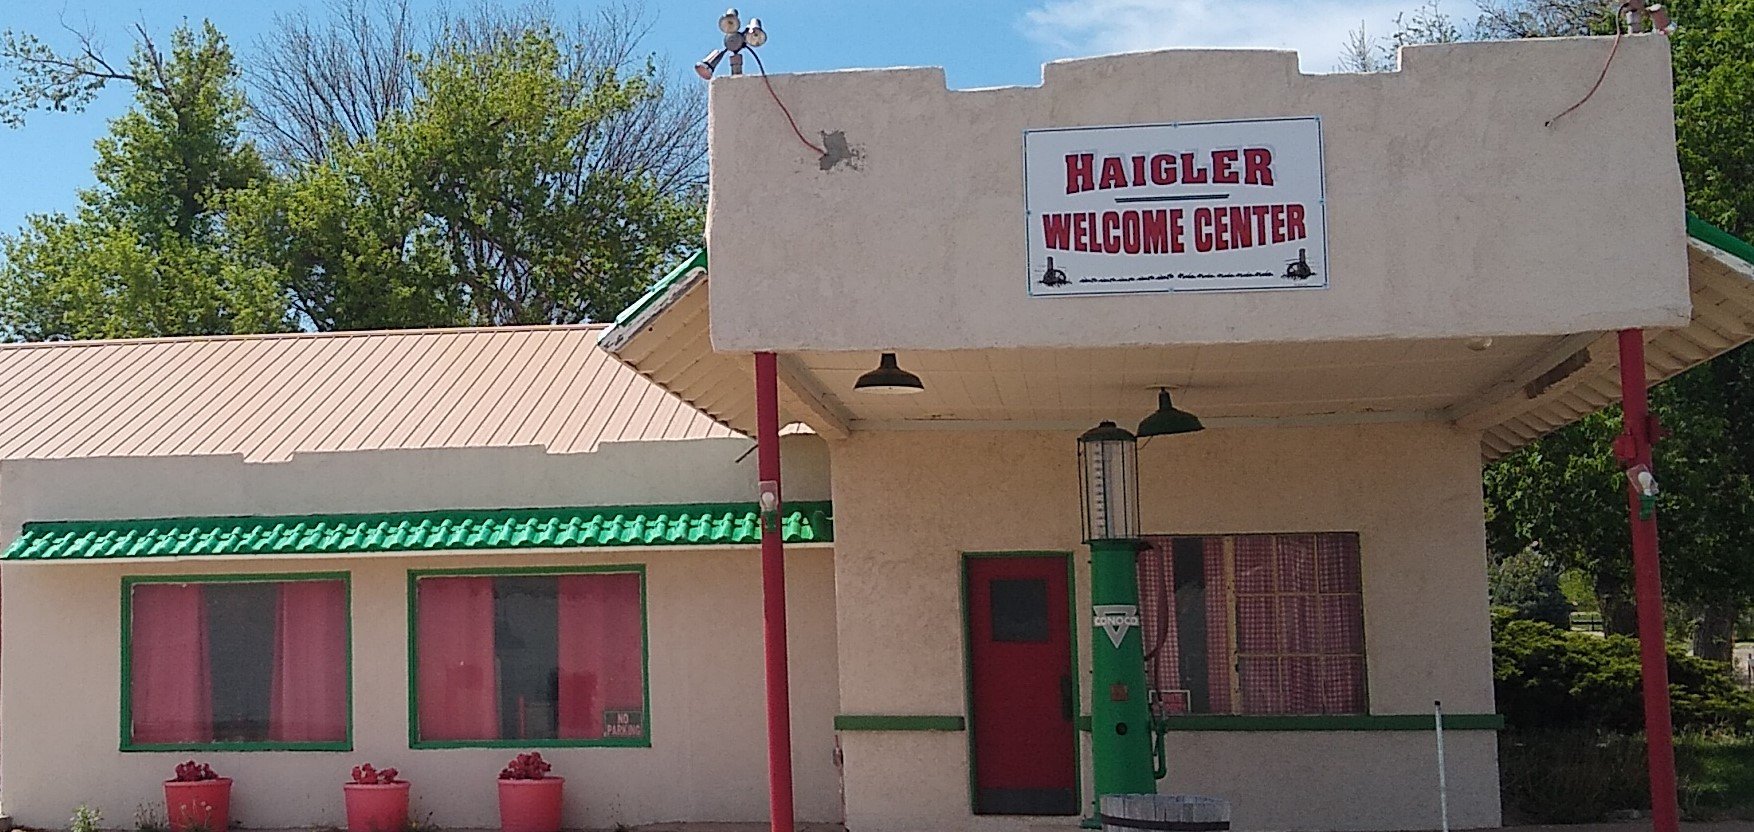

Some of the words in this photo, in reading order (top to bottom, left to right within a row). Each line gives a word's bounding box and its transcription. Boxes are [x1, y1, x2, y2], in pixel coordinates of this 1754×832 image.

[1064, 148, 1274, 195] HAIGLER
[1041, 207, 1186, 255] WELCOME
[1194, 203, 1307, 253] CENTER
[1094, 616, 1137, 626] CONOCO
[617, 713, 629, 724] NO
[607, 724, 641, 736] PARKING
